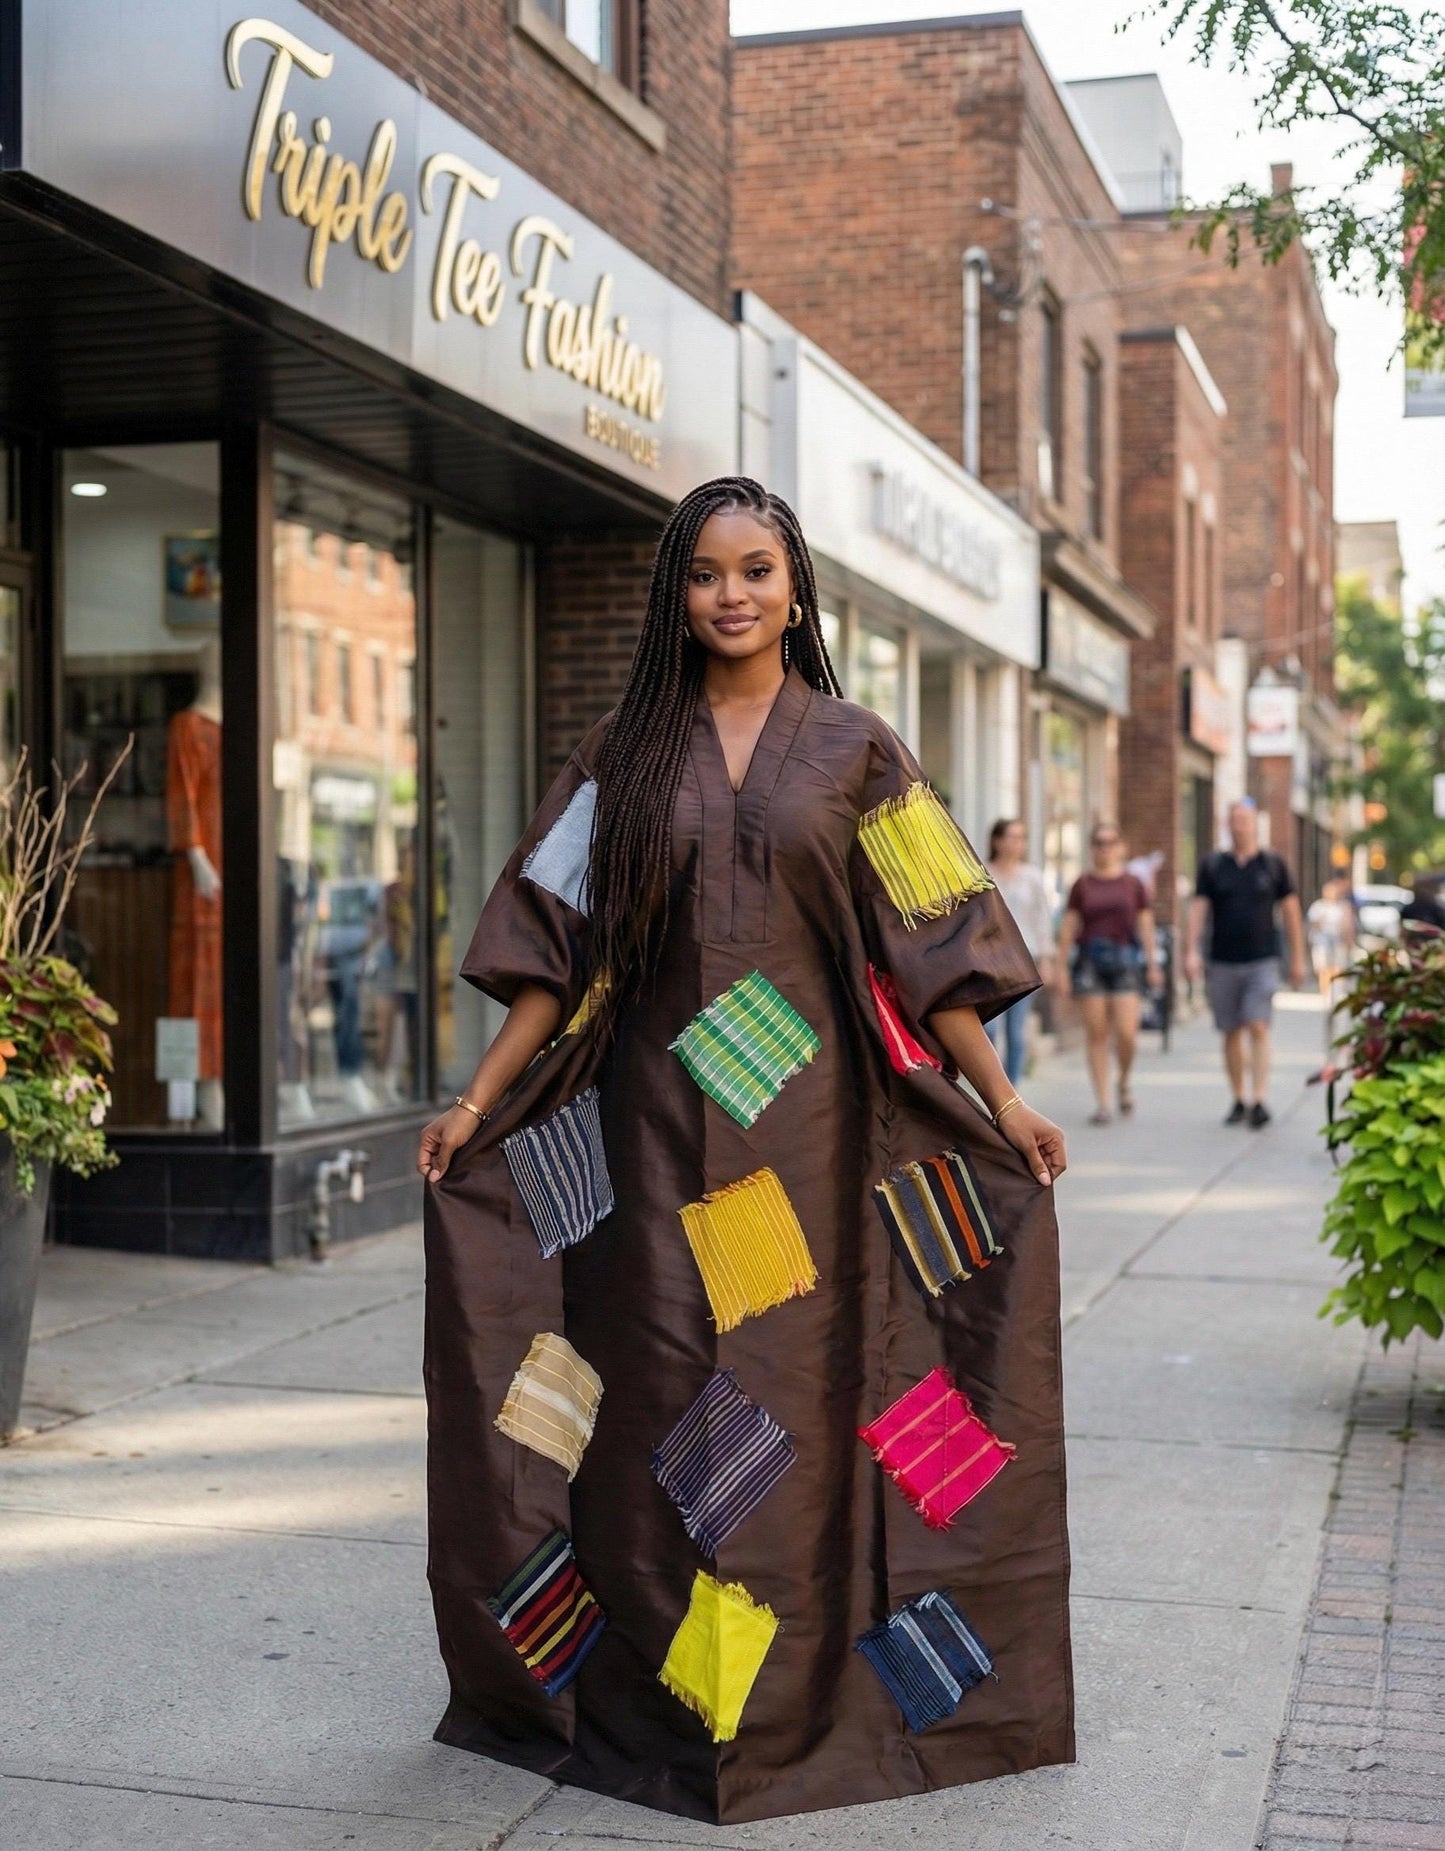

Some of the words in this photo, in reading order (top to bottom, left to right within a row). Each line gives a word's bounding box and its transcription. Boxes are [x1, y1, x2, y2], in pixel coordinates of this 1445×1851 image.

[227, 18, 413, 289] Triple
[421, 153, 505, 327] Tee
[510, 215, 665, 422] Fashion
